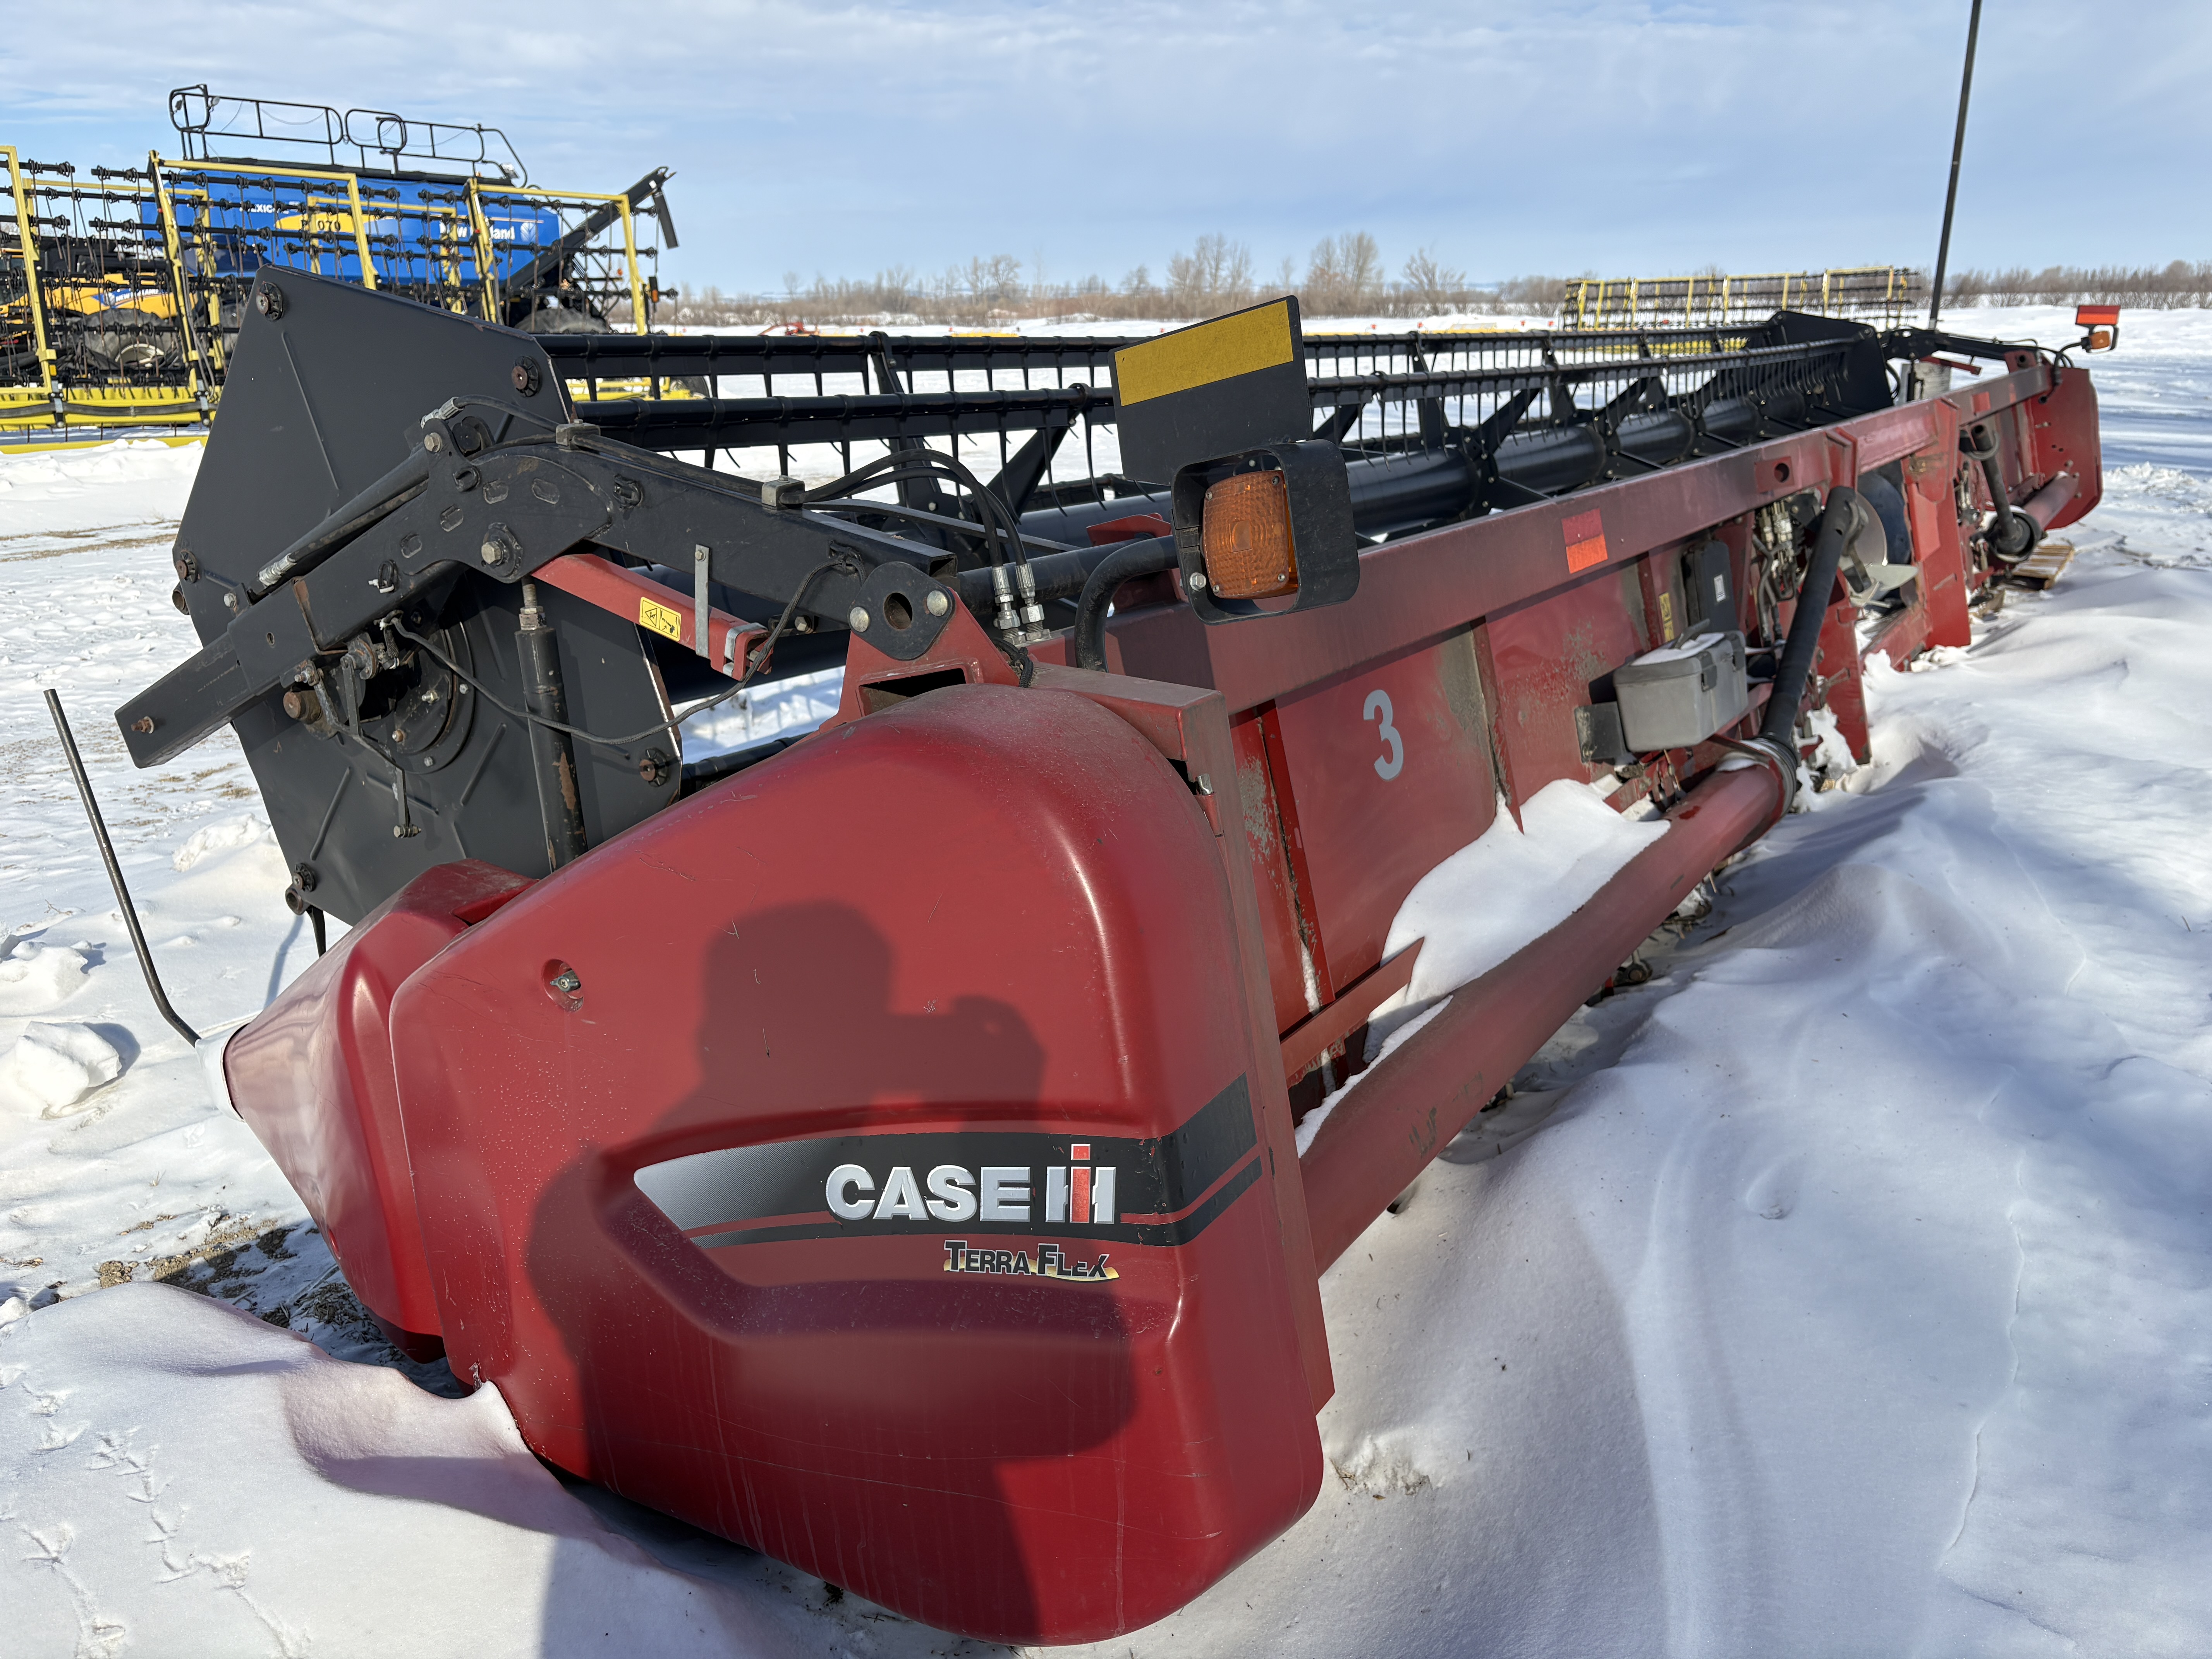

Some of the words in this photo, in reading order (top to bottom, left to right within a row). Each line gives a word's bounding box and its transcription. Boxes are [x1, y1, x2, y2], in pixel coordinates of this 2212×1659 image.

[439, 221, 467, 237] Nw
[470, 222, 515, 240] land
[1363, 689, 1403, 780] 3
[825, 1164, 1031, 1222] CASE
[944, 1240, 1031, 1275] TERRA
